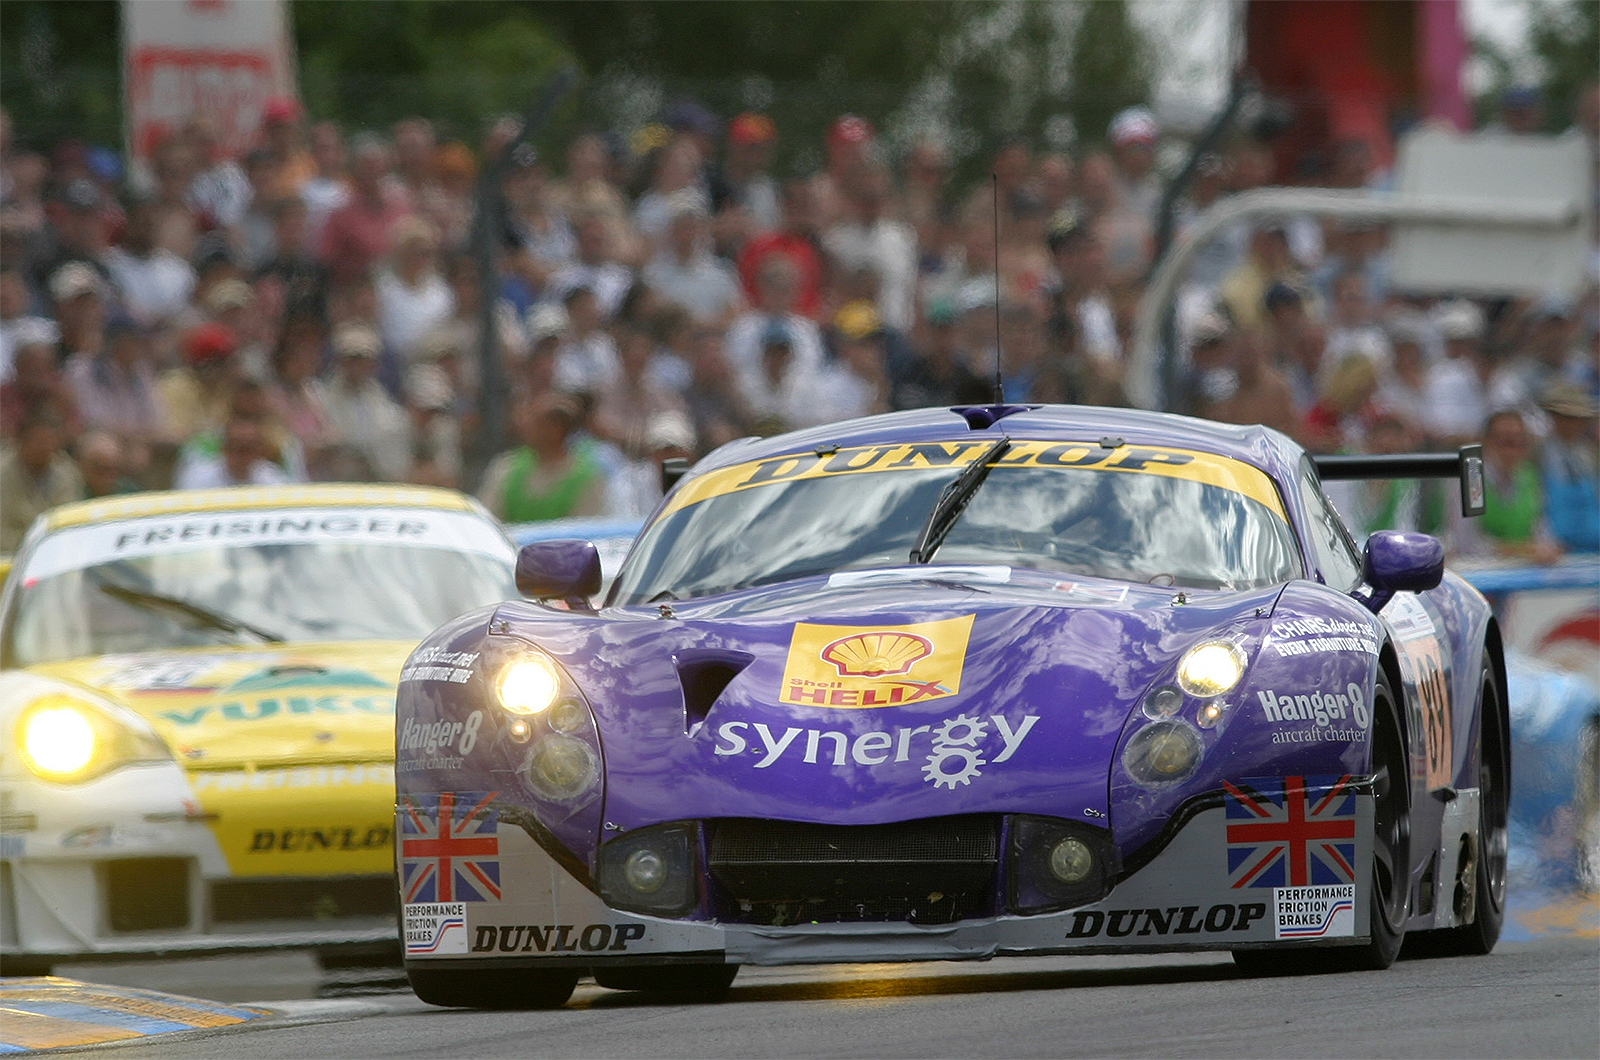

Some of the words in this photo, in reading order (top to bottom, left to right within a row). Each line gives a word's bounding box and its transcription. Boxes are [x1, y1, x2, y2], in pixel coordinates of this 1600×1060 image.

[737, 441, 1197, 488] DUNLOP
[115, 517, 431, 549] FREISINGER
[1273, 638, 1311, 657] EVENT
[1307, 637, 1365, 652] FURNITURE
[789, 680, 945, 706] HELIX
[790, 678, 842, 688] Shell
[1257, 690, 1350, 727] Hanger
[1347, 683, 1369, 729] 8
[400, 717, 463, 756] Hanger
[459, 710, 483, 756] 8
[1272, 725, 1323, 744] aircraft
[1324, 725, 1367, 742] charter
[714, 714, 1040, 789] synergy
[426, 755, 465, 770] charter
[248, 825, 392, 854] DUNLO
[1278, 887, 1352, 900] PERFORMANCE
[405, 905, 463, 917] PERFORMANCE
[1278, 901, 1328, 913] FRICTION
[405, 918, 438, 929] FRICTION
[1065, 903, 1267, 938] DUNLOP
[1279, 914, 1322, 926] BRAKES
[406, 930, 433, 942] BRAKES
[472, 924, 646, 952] DUNLOP
